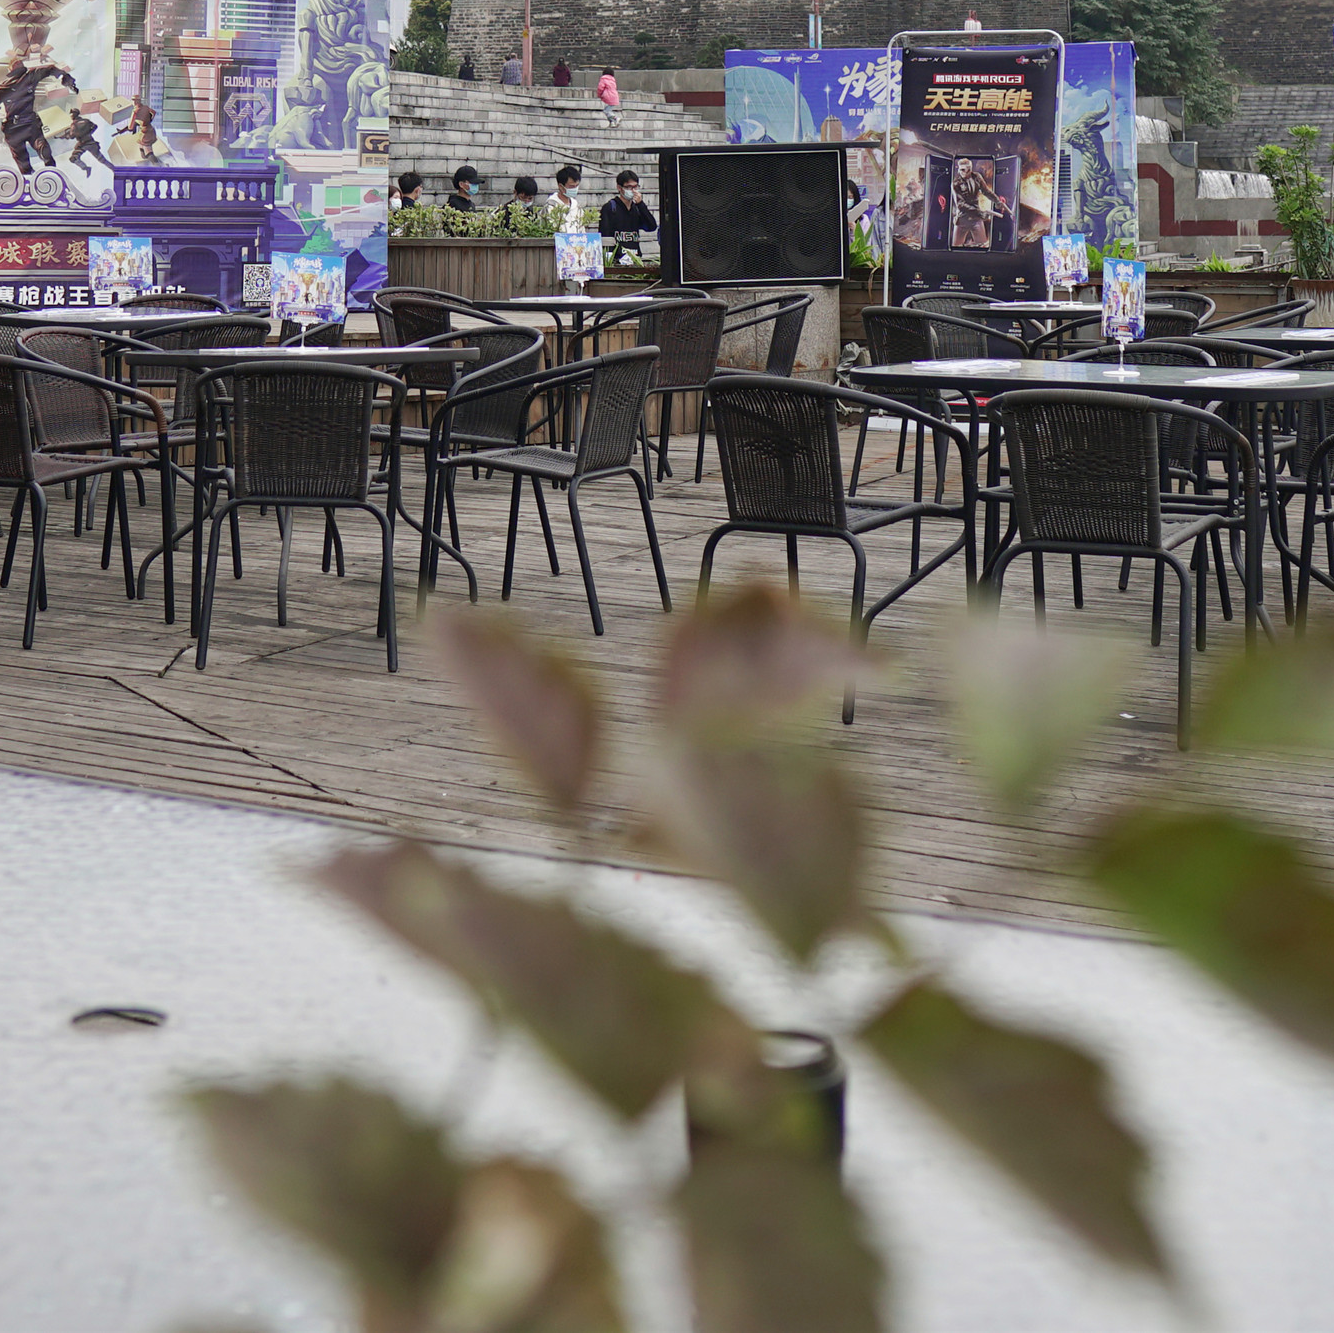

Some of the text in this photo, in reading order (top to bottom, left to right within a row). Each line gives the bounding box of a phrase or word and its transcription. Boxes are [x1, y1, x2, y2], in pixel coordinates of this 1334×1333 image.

[223, 75, 278, 90] GLOBAL RISK
[923, 87, 1033, 111] 天生高能
